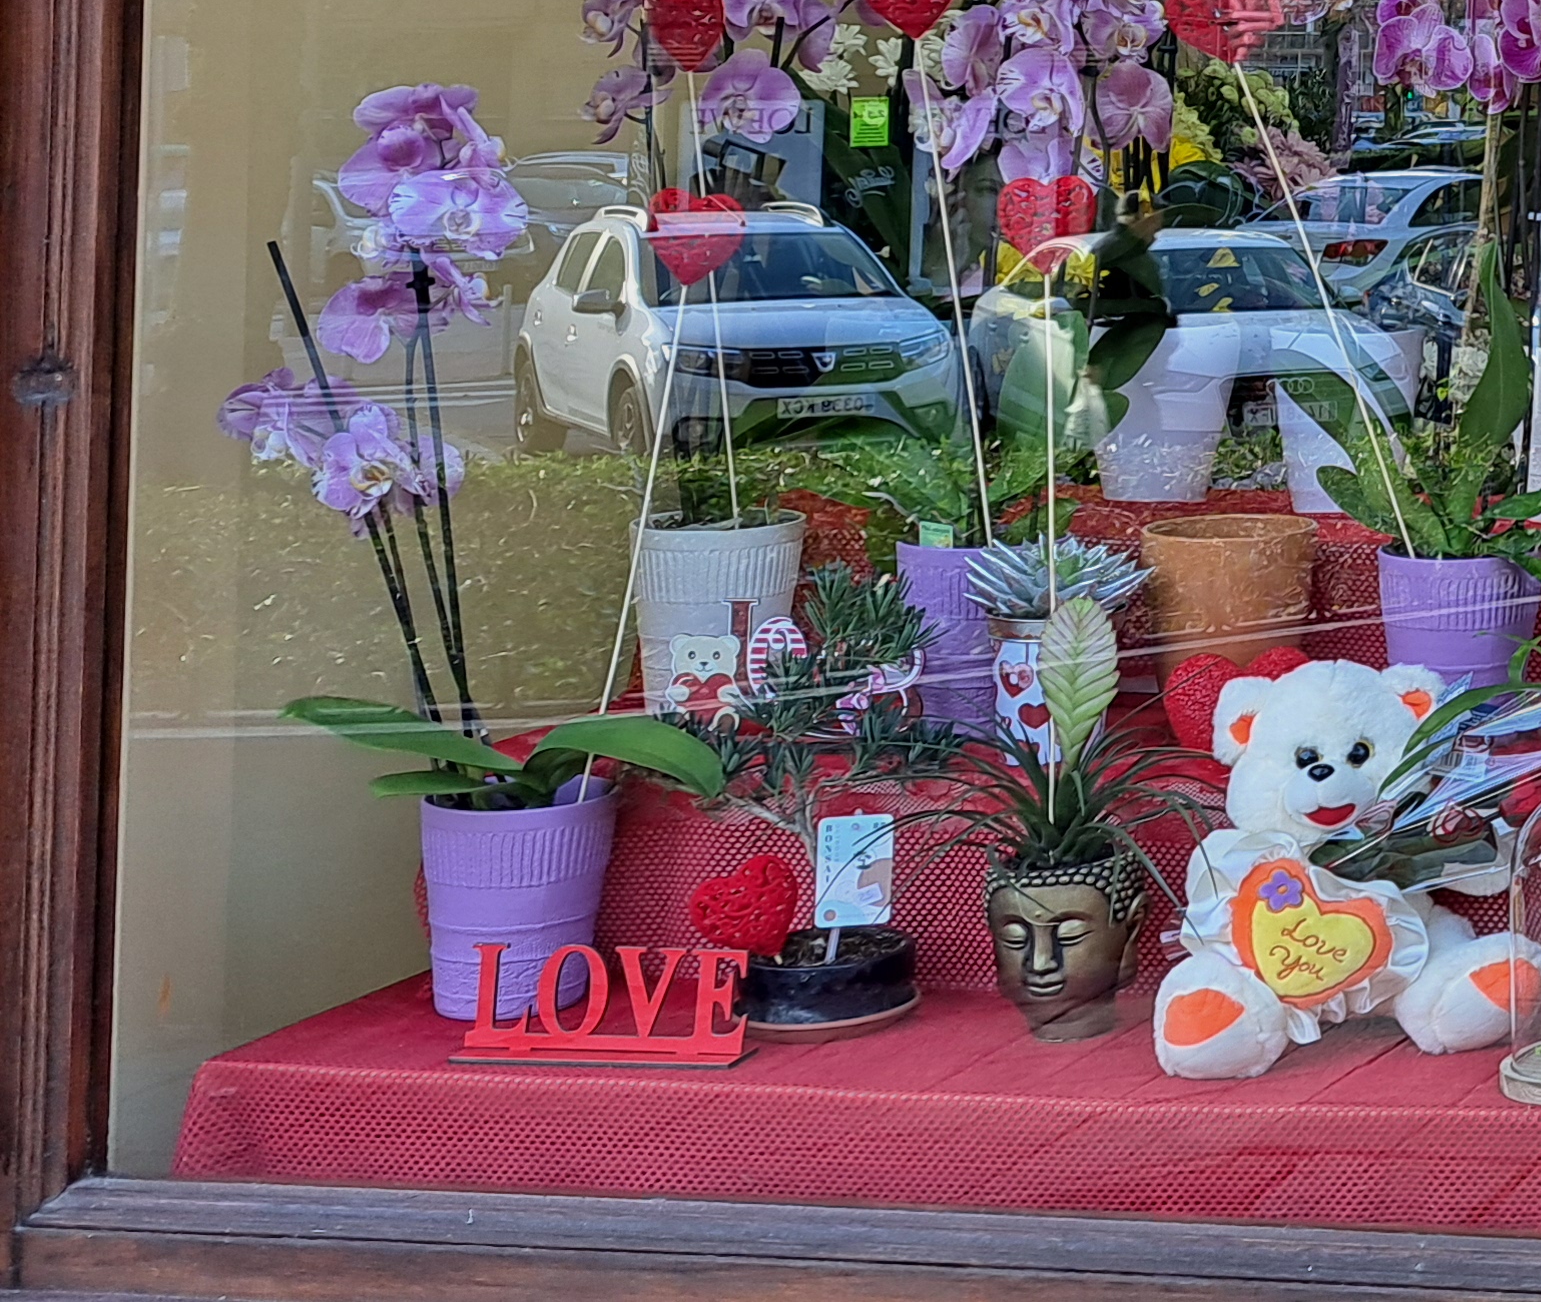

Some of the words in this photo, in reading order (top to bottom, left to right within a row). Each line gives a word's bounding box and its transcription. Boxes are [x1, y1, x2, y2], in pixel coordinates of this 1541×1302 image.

[1268, 944, 1325, 982] You
[1281, 917, 1348, 964] Love
[464, 942, 749, 1055] LOVE
